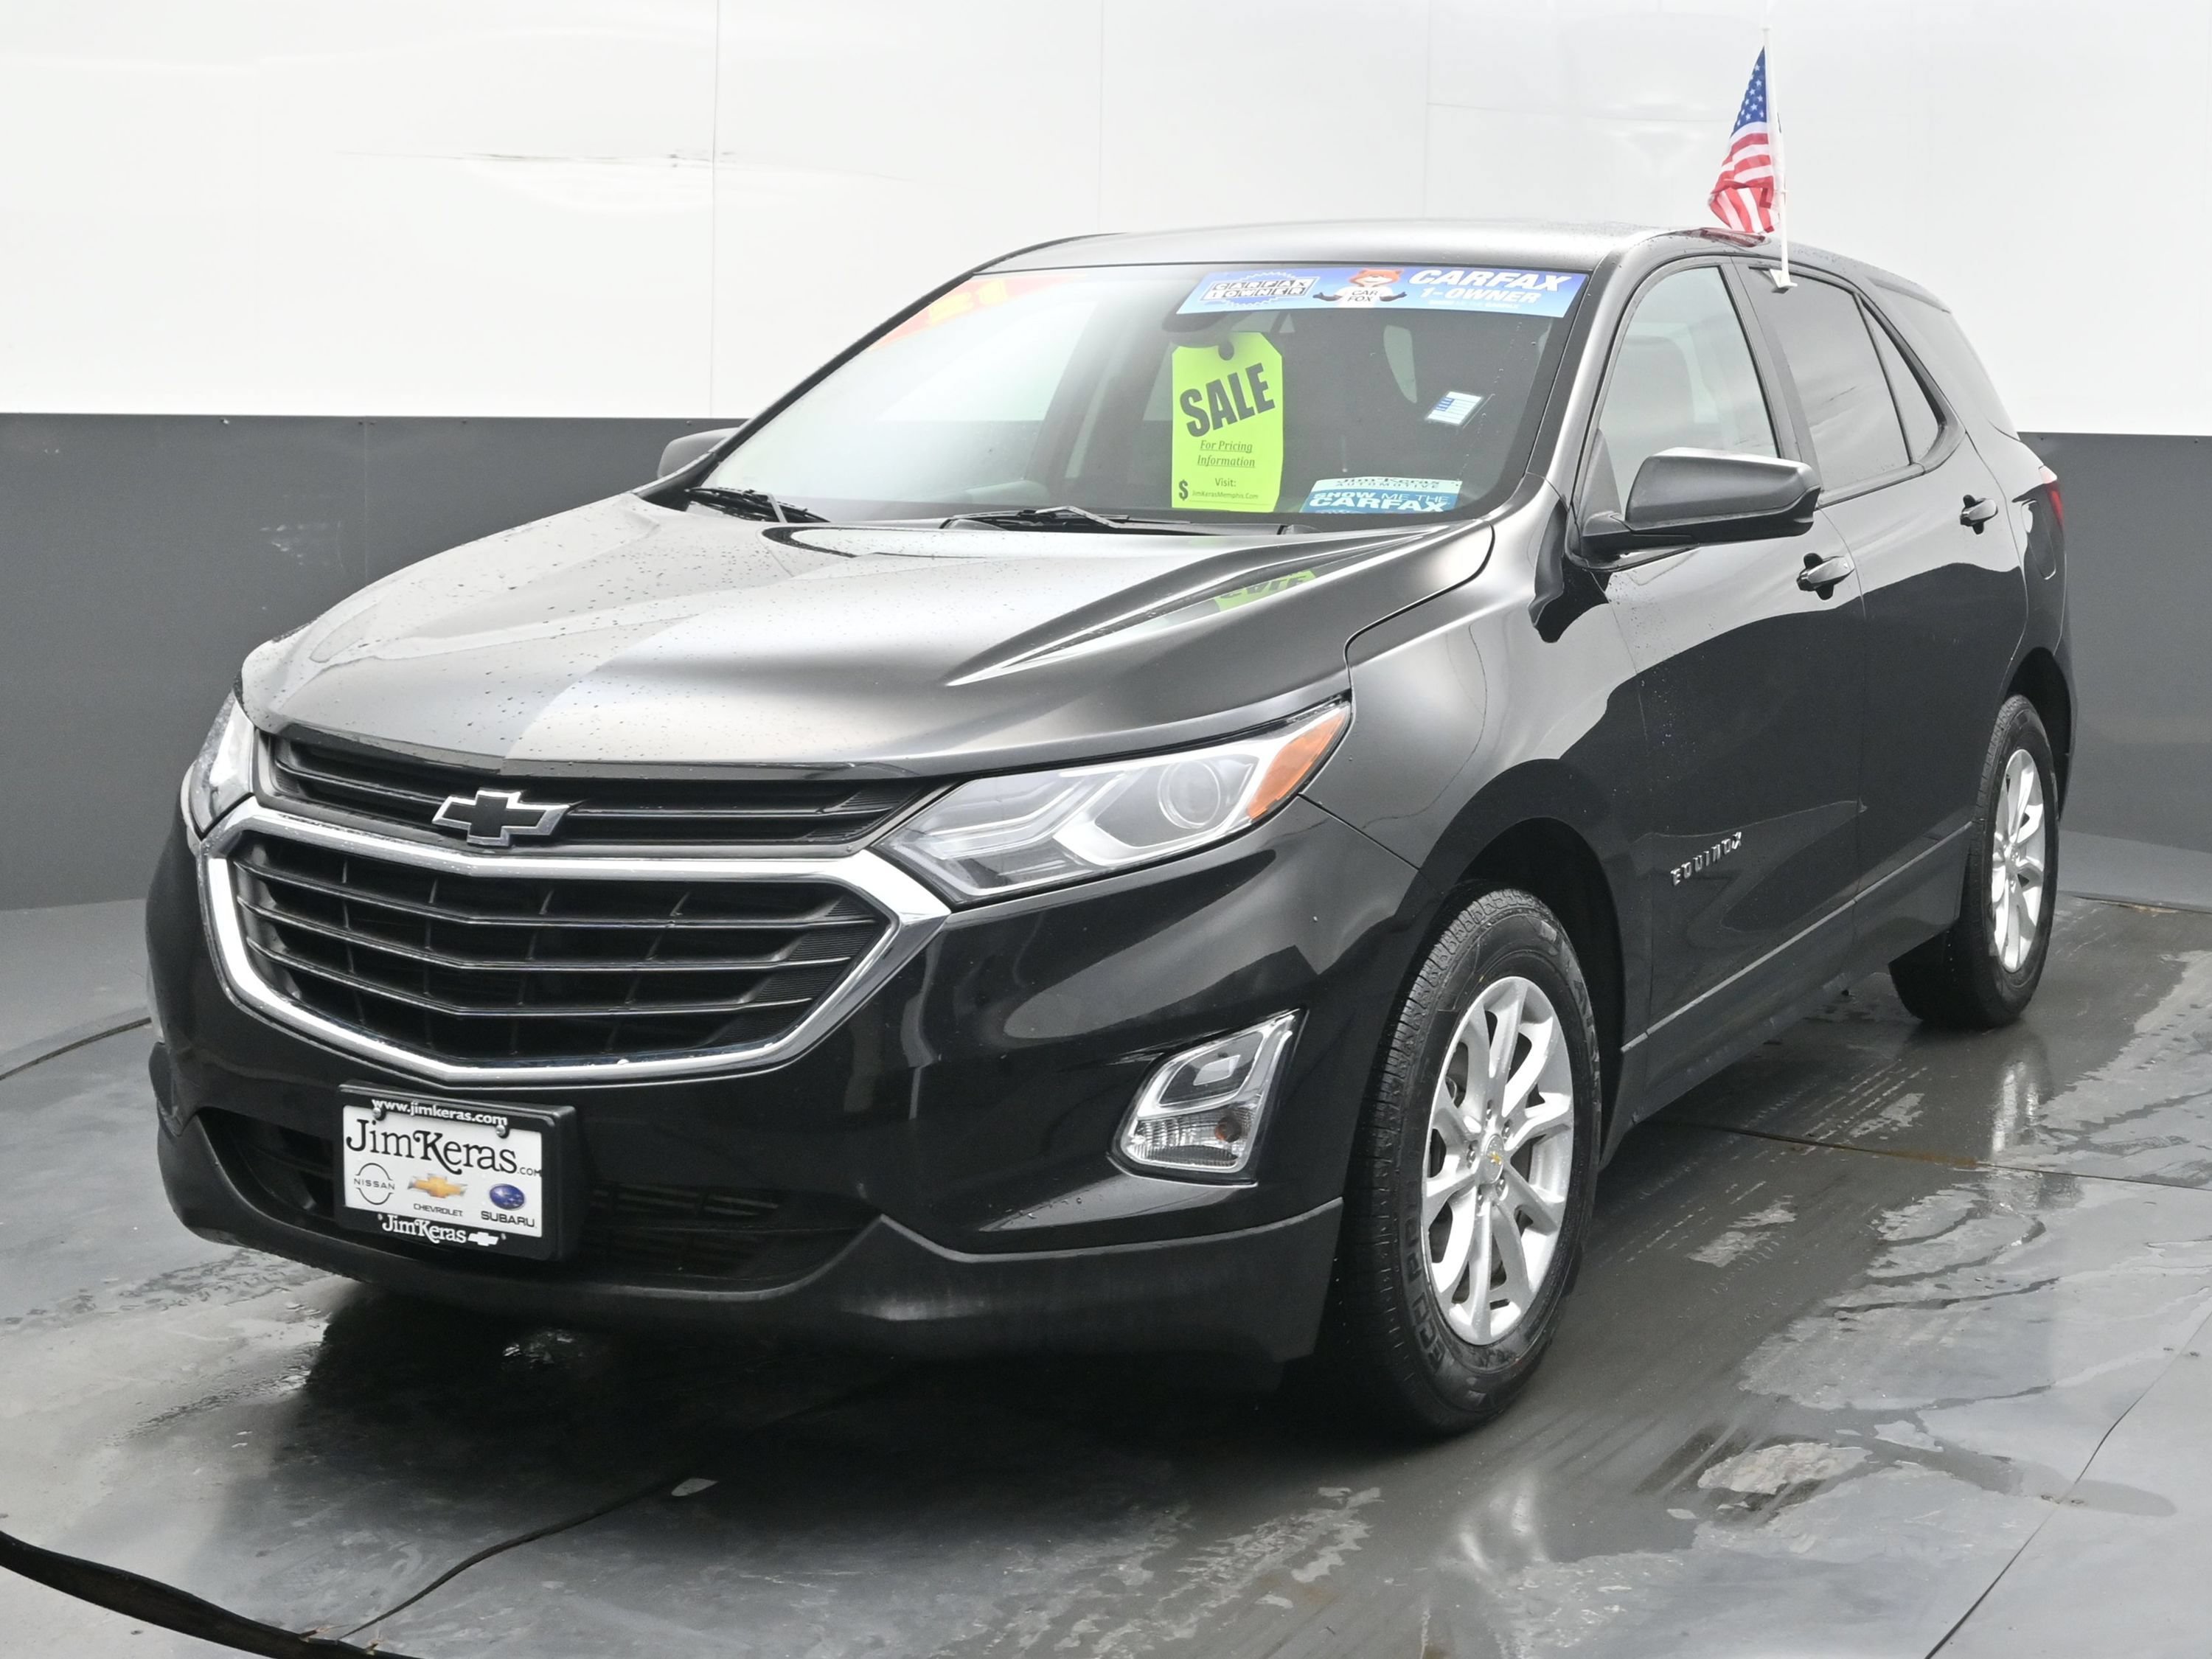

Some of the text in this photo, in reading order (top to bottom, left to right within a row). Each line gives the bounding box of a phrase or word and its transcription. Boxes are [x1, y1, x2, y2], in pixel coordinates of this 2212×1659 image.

[1409, 270, 1571, 291] CARFAX
[1422, 287, 1542, 303] 1-OWNER
[1180, 362, 1276, 437] SALE
[1200, 440, 1253, 453] For Pricing
[1197, 454, 1255, 467] Information
[1178, 479, 1189, 501] $
[1215, 478, 1237, 487] Visit:
[1309, 497, 1449, 512] CARFAX
[1312, 491, 1377, 499] SHOW
[1415, 494, 1450, 503] THE
[1670, 832, 1742, 886] EQUINOX
[372, 1099, 508, 1126] www.jimkeras.com
[354, 1178, 395, 1190] NISSAN
[414, 1203, 463, 1217] CHEVROLET
[481, 1210, 535, 1228] SUBARU
